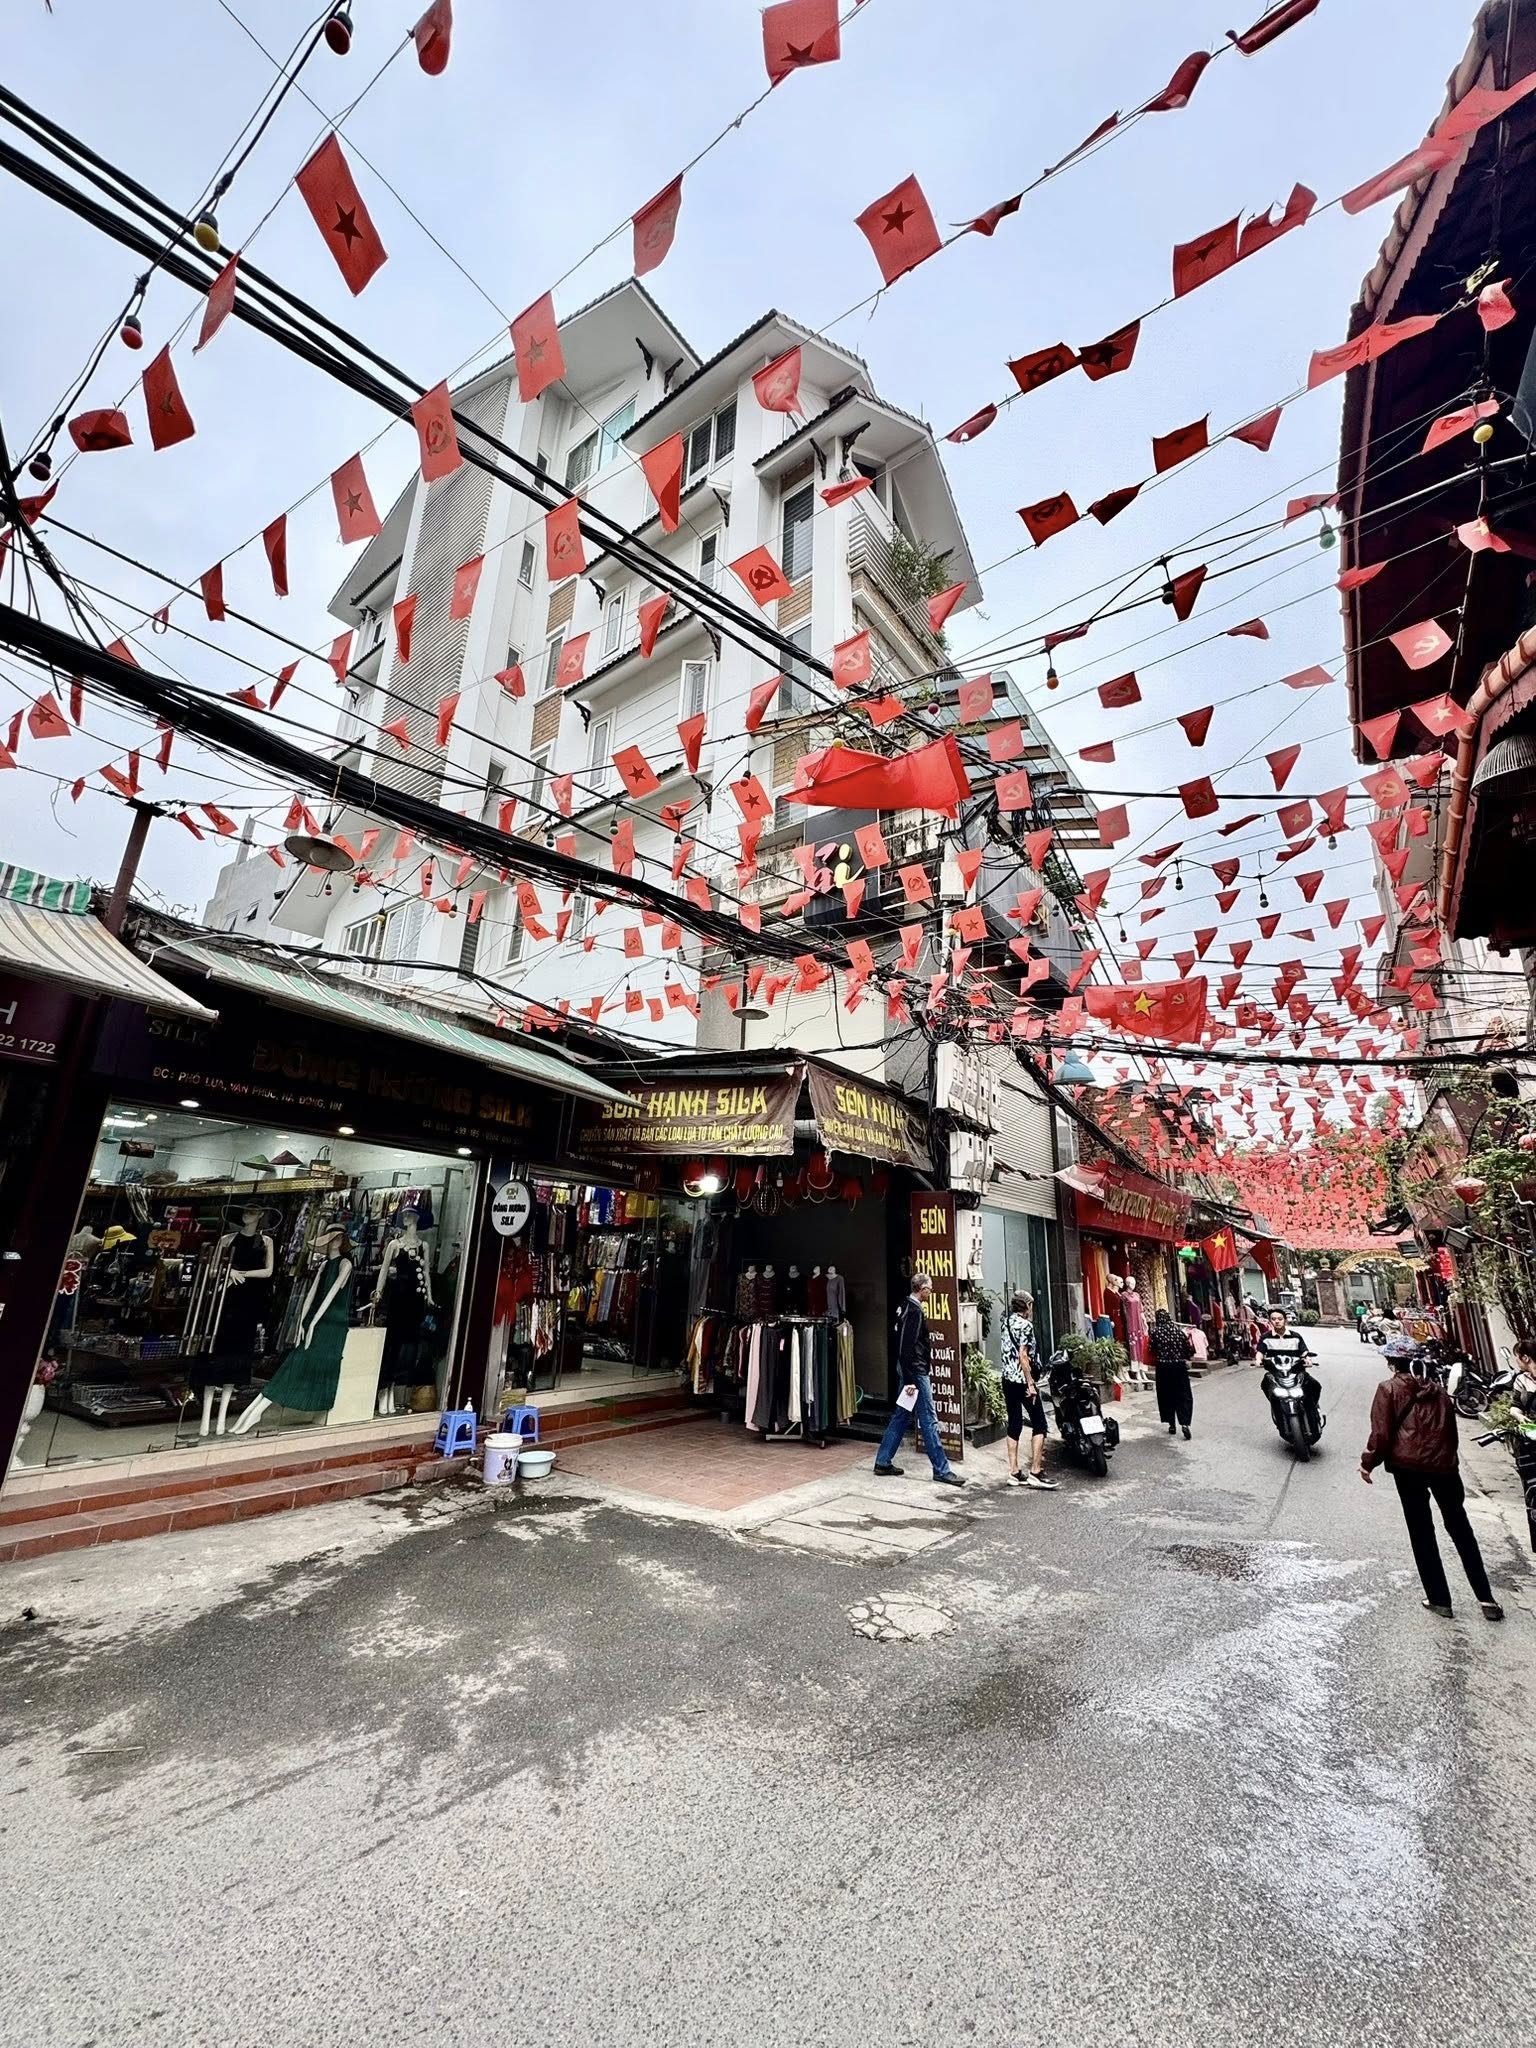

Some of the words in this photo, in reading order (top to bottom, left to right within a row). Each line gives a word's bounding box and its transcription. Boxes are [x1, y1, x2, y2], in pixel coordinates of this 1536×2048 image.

[20, 1038, 56, 1054] 1722
[646, 1089, 710, 1124] HẠNH
[716, 1086, 768, 1115] SILK
[836, 1085, 868, 1119] SƠN
[769, 1124, 784, 1140] CAO
[500, 1216, 515, 1226] SILK
[920, 1204, 946, 1234] SƠN
[934, 1346, 956, 1361] XUẤT
[935, 1364, 951, 1378] BÁN
[937, 1383, 954, 1397] LOẠI
